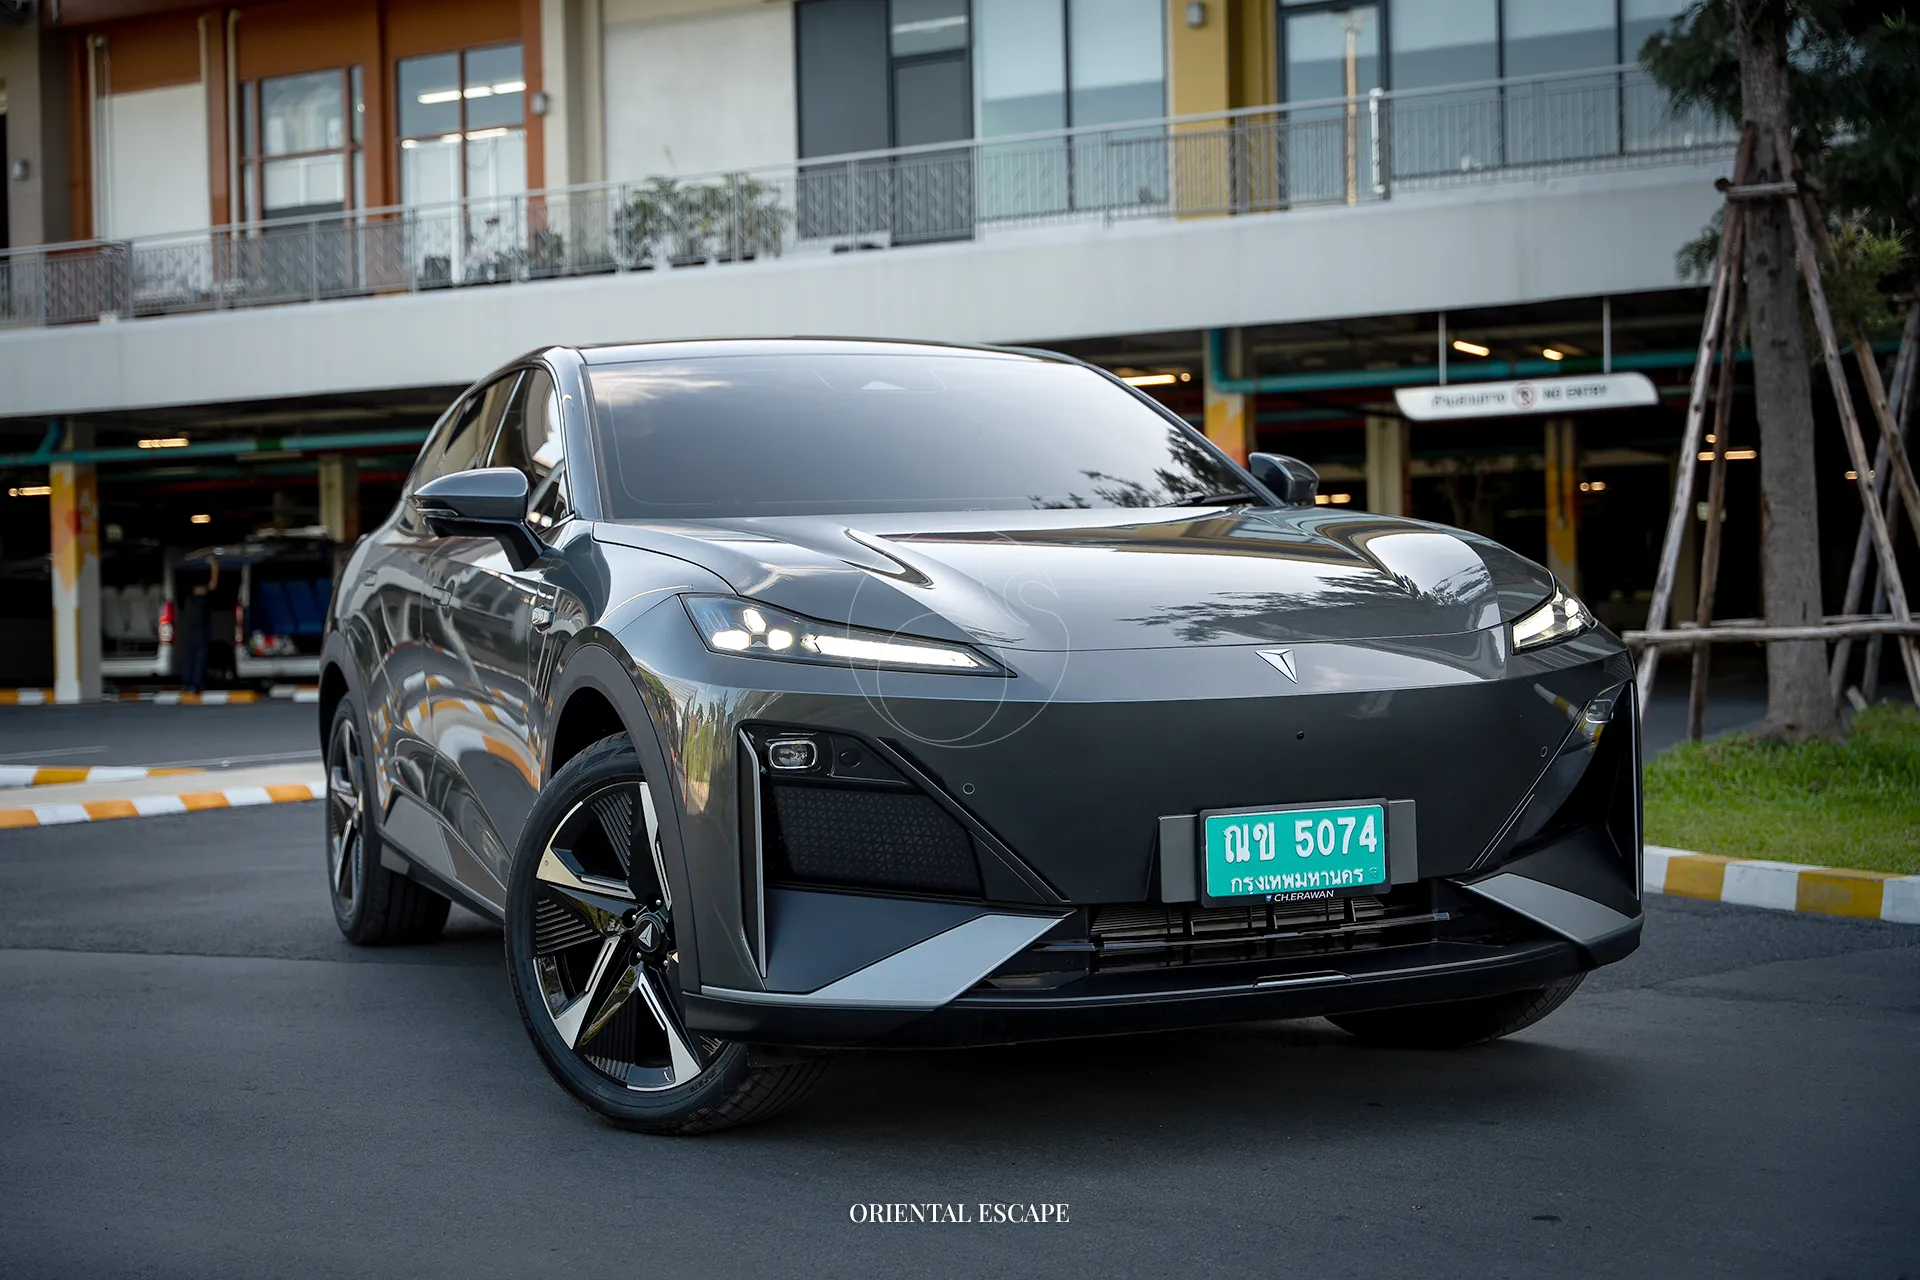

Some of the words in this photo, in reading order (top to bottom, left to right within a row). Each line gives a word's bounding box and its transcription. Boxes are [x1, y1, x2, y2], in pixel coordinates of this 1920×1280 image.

[1223, 821, 1276, 864] ณข
[1294, 814, 1378, 859] 5074
[1230, 867, 1364, 895] กรุงเทพมหานคร
[1273, 889, 1335, 903] CH.ERAWAN
